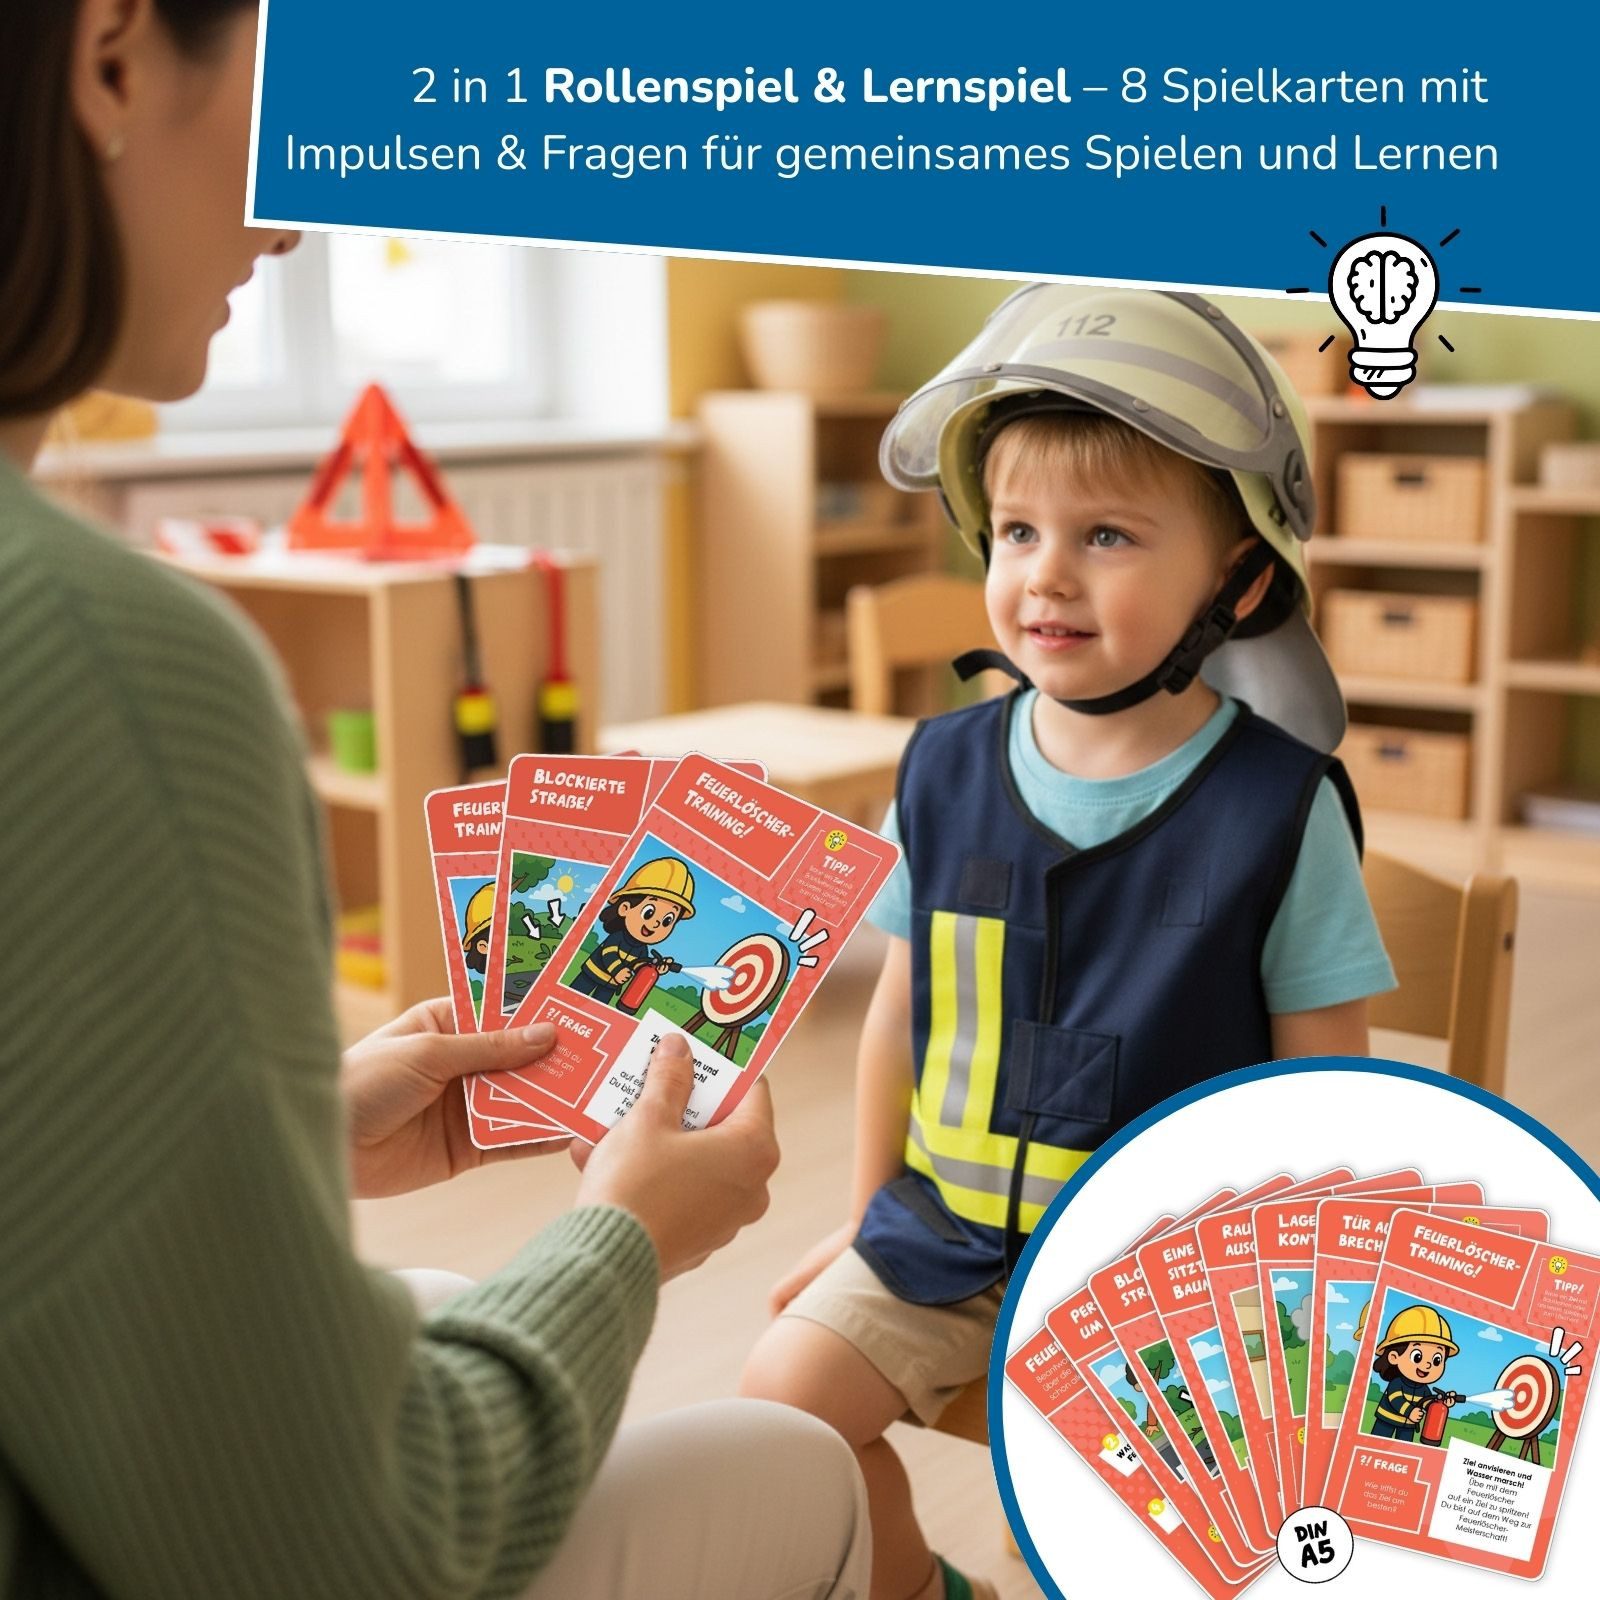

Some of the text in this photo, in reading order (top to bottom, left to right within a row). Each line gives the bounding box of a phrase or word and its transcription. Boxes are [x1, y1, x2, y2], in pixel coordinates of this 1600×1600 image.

[1057, 314, 1117, 337] 112
[533, 768, 626, 795] BLOCKIERTE
[683, 789, 754, 839] TRAINING!
[695, 772, 795, 838] FEUERLÖSCHER-
[823, 855, 856, 877] TIPP!
[558, 1015, 593, 1038] FRAGE
[620, 1071, 634, 1083] auf
[702, 1064, 719, 1077] und
[609, 1076, 621, 1088] Du
[620, 1083, 636, 1097] bist
[1343, 1215, 1371, 1231] TÜR
[1162, 1243, 1195, 1263] EINE
[1414, 1225, 1521, 1271] FEUERLÖSCHER-
[1409, 1243, 1483, 1278] TRAINING!
[1554, 1279, 1584, 1294] TIPP!
[1080, 1319, 1104, 1340] UM
[1374, 1458, 1409, 1474] FRAGE
[1463, 1457, 1533, 1481] Ziel anvisieren und
[1466, 1468, 1525, 1488] Wasser marsch!
[1468, 1477, 1518, 1496] Übe mit dem
[1447, 1493, 1461, 1502] auf
[1462, 1497, 1474, 1505] ein
[1475, 1499, 1488, 1508] Ziel
[1440, 1500, 1452, 1509] Du
[1453, 1503, 1466, 1513] bist
[1467, 1508, 1481, 1517] auf
[1482, 1511, 1501, 1521] dem
[1501, 1515, 1519, 1527] Weg
